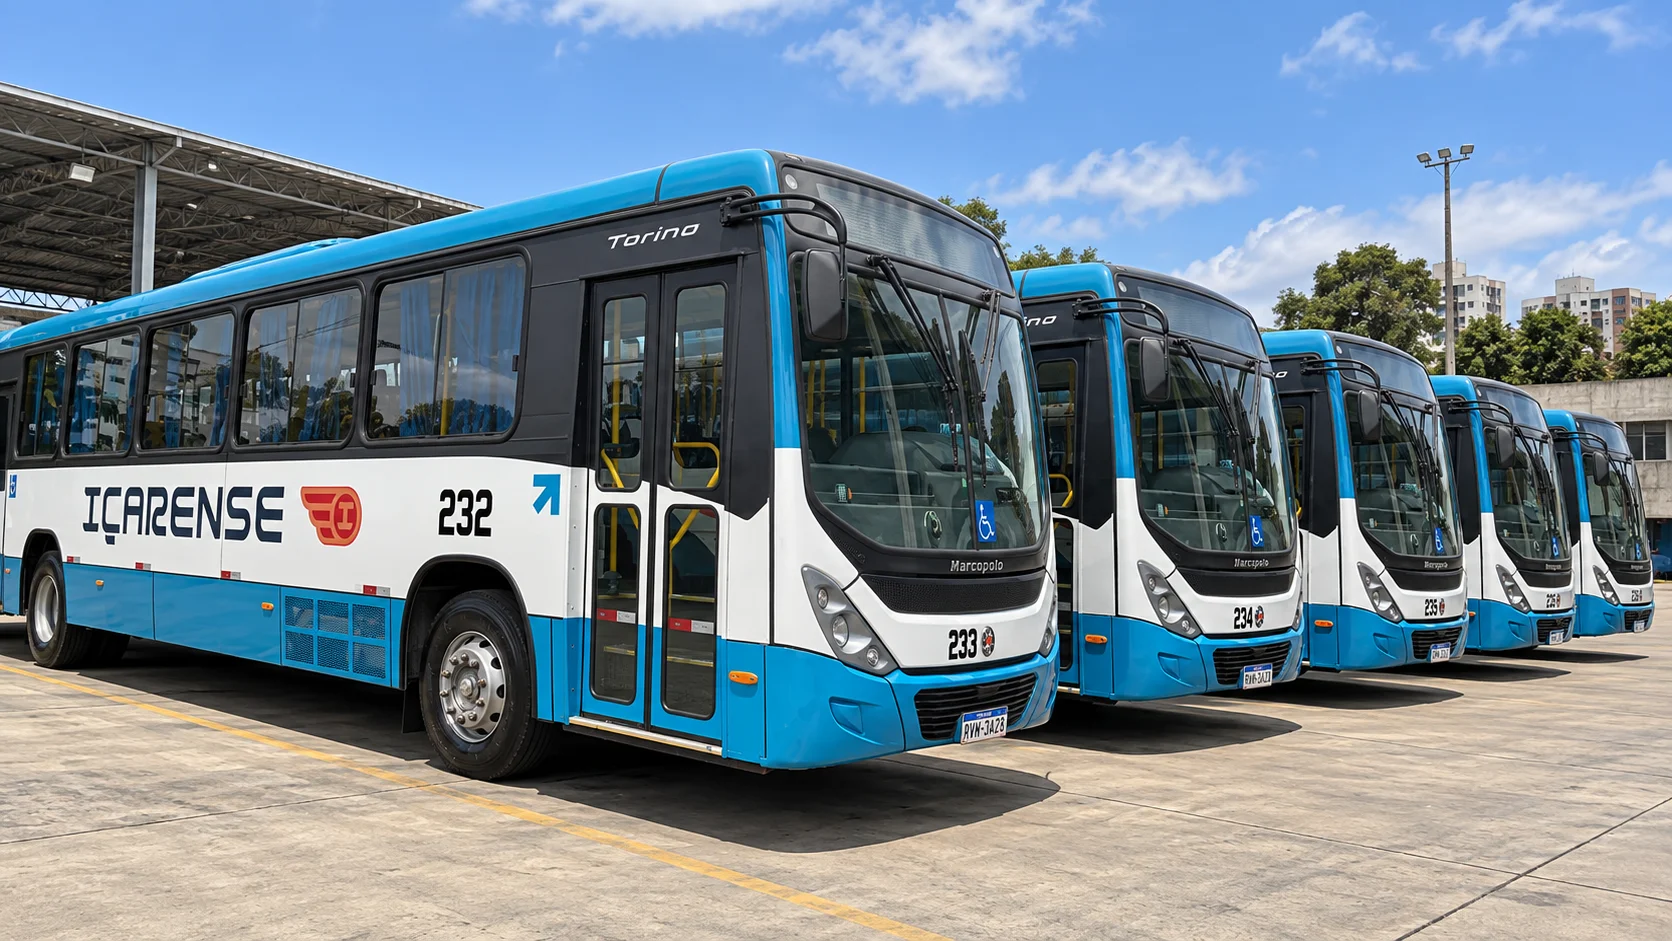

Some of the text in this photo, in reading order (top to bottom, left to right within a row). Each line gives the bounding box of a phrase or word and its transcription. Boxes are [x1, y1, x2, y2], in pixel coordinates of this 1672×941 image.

[607, 223, 701, 250] Torino
[82, 486, 285, 546] IÇARENSE
[438, 489, 493, 537] 232
[950, 559, 1004, 574] Marcopolo
[1233, 607, 1253, 629] 234
[948, 628, 978, 660] 233
